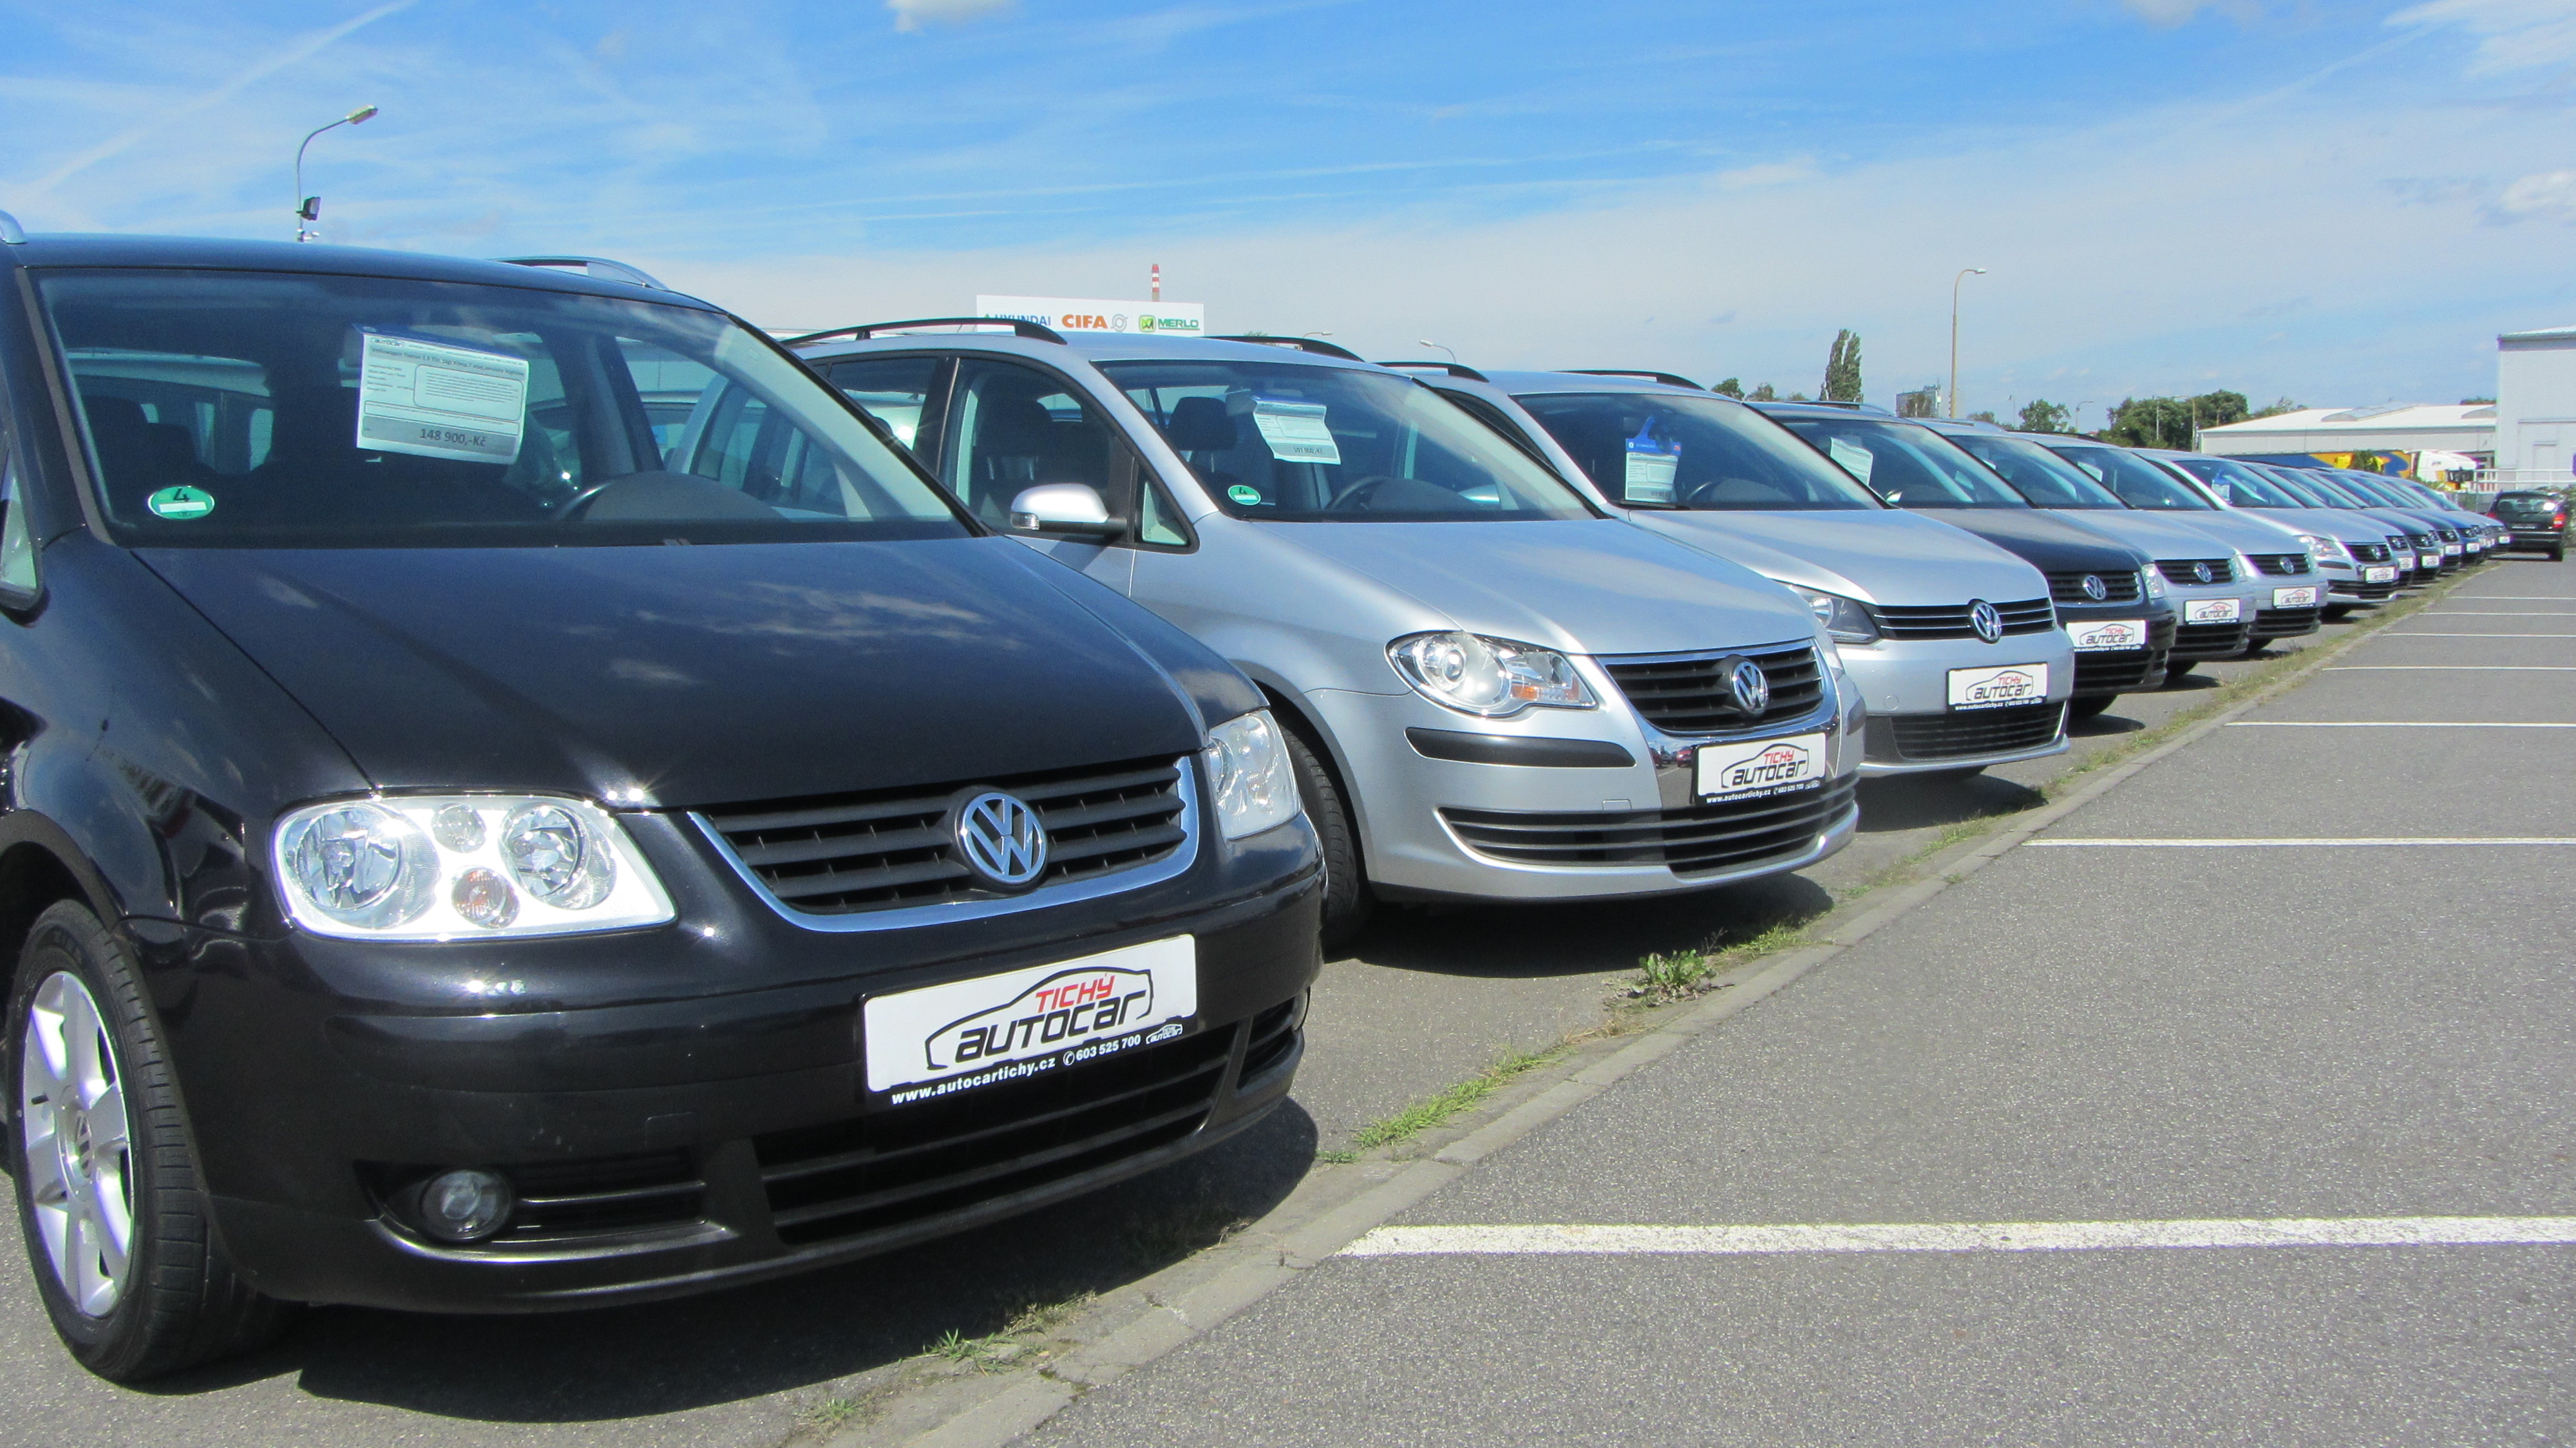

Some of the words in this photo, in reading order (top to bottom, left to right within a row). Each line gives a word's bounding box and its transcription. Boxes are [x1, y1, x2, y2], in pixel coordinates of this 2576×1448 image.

[1062, 314, 1108, 329] CIFA
[1158, 318, 1198, 328] MERLO
[420, 428, 441, 441] 148
[173, 488, 190, 502] 4
[1238, 486, 1247, 495] 4
[1733, 662, 1768, 714] VW
[1707, 789, 1770, 803] www.autocartichy.cz
[962, 792, 1046, 884] VW
[891, 1058, 1056, 1104] www.autocartichy.cz
[1075, 1046, 1097, 1061] 603
[1099, 1040, 1119, 1056] 525
[1121, 1034, 1141, 1049] 700
